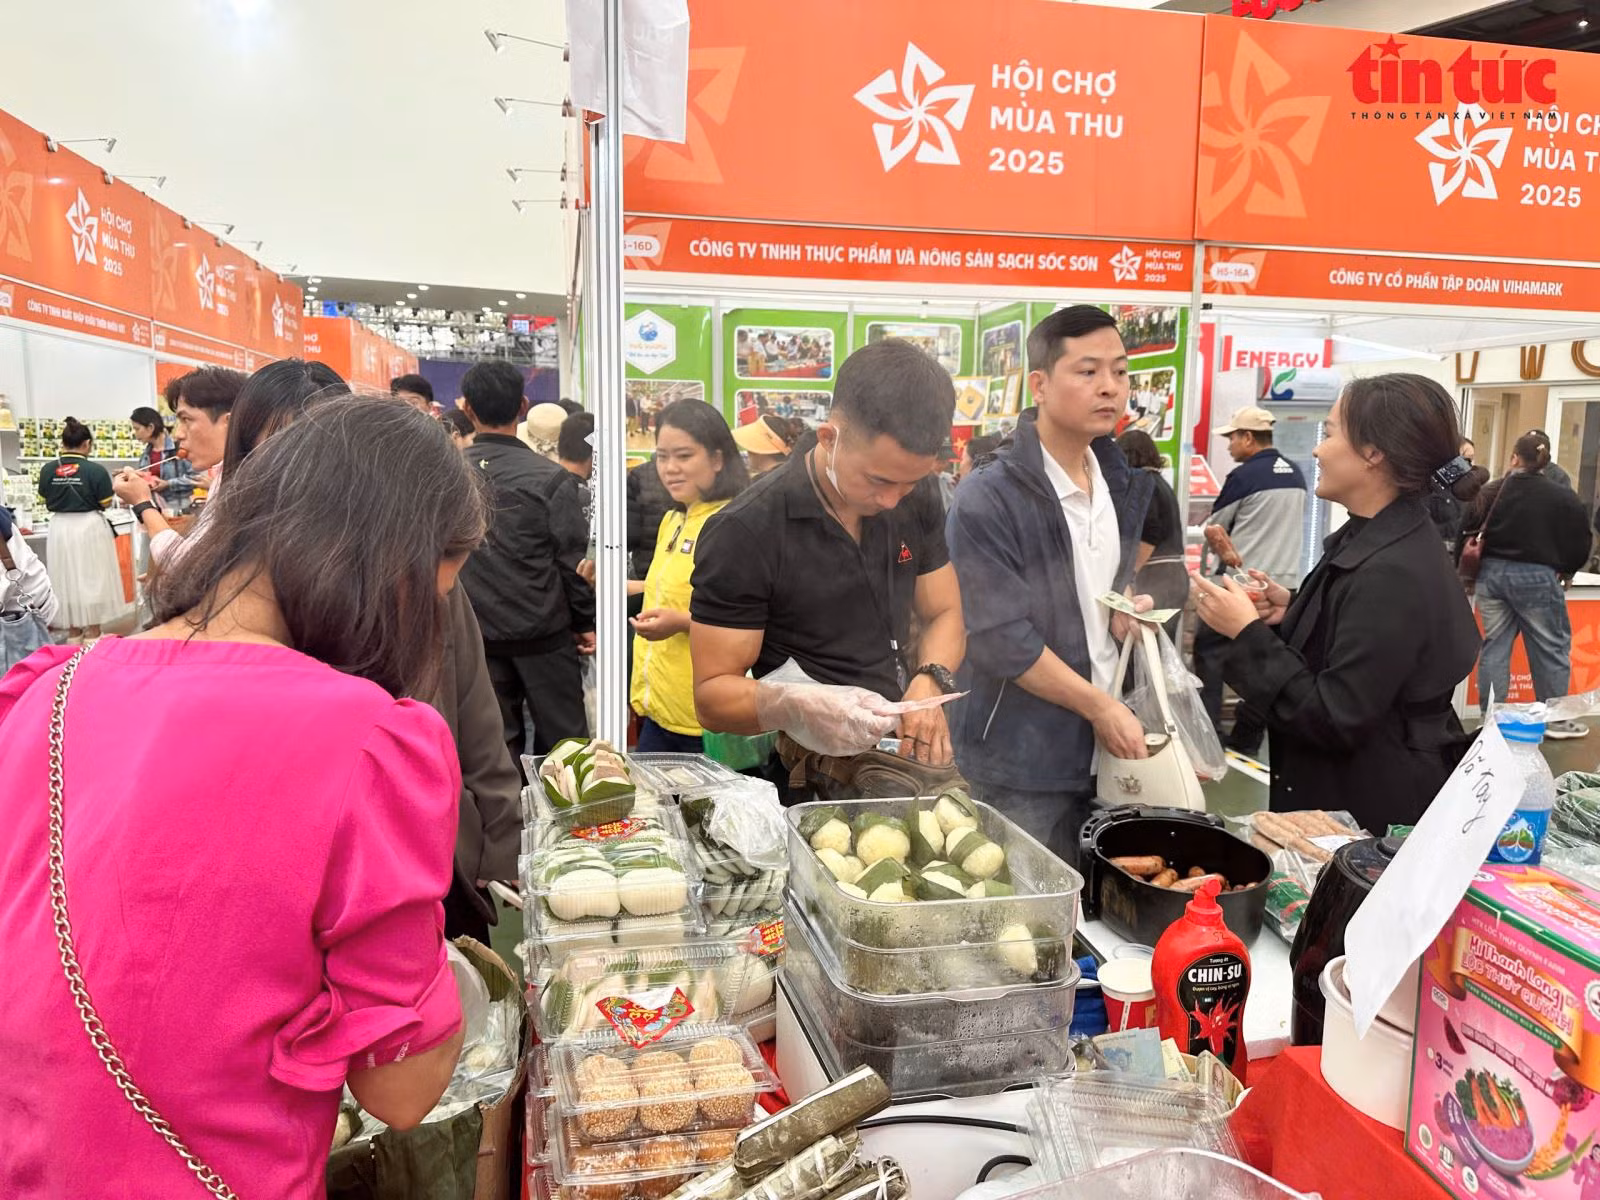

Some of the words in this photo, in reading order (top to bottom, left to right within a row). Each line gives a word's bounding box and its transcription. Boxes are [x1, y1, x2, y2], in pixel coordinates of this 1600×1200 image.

[991, 59, 1044, 98] HỘI
[1051, 69, 1117, 104] CHỢ
[990, 100, 1056, 134] MÙA
[1064, 111, 1124, 139] THU
[1526, 104, 1570, 139] HỘI
[988, 147, 1065, 175] 2025
[1523, 141, 1577, 172] MÙA
[1520, 183, 1582, 208] 2025
[101, 207, 115, 229] HỘI
[116, 216, 132, 239] CHỢ
[102, 231, 119, 252] MÙA
[120, 240, 135, 259] THU
[689, 237, 734, 257] CÔNG
[737, 242, 758, 258] TY
[759, 243, 801, 261] TNHH
[804, 245, 844, 265] THỰC
[848, 242, 892, 265] PHẨM
[895, 246, 915, 266] VÀ
[918, 247, 961, 267] NÔNG
[965, 250, 994, 268] SẢN
[997, 253, 1034, 271] SẠCH
[1037, 251, 1067, 271] SÓC
[1069, 254, 1099, 272] SƠN
[1145, 248, 1161, 262] HỘI
[1162, 250, 1182, 261] CHỢ
[104, 256, 123, 277] 2025
[1144, 261, 1165, 271] MÙA
[1166, 263, 1184, 272] THU
[1144, 273, 1167, 283] 2025
[1329, 267, 1365, 286] CÔNG
[1367, 272, 1383, 287] TY
[1384, 268, 1403, 288] CỔ
[1441, 273, 1463, 293] TẬP
[1466, 275, 1500, 293] ĐOÀN
[1502, 279, 1564, 297] VIHAMARK
[1236, 350, 1319, 368] ENERGY
[1188, 963, 1242, 983] CHIN-SU
[1526, 967, 1564, 1009] Long
[1435, 1051, 1443, 1070] 3
